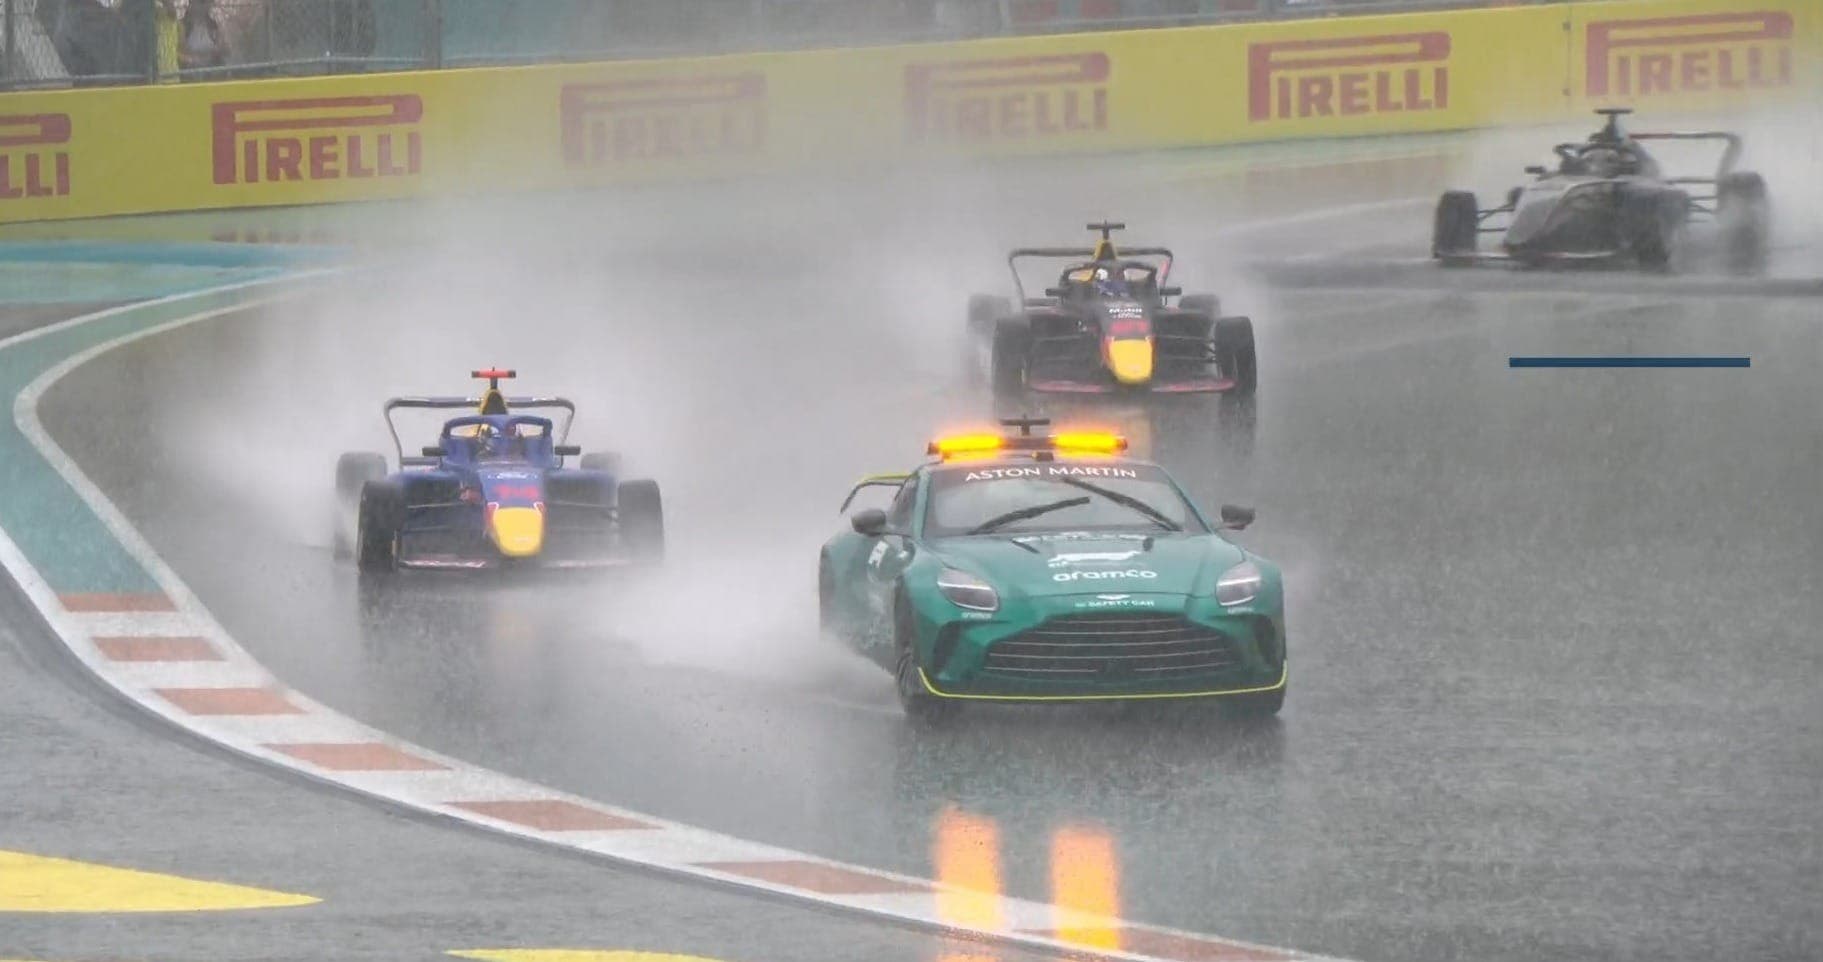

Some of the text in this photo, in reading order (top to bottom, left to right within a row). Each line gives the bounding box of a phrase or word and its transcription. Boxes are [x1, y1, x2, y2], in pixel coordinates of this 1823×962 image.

[1248, 31, 1452, 122] PIRELLI
[1585, 11, 1795, 97] PIRELLI
[211, 93, 423, 184] PIRELLI
[965, 467, 1137, 482] ASTON MARTIN
[1052, 569, 1158, 582] aramco
